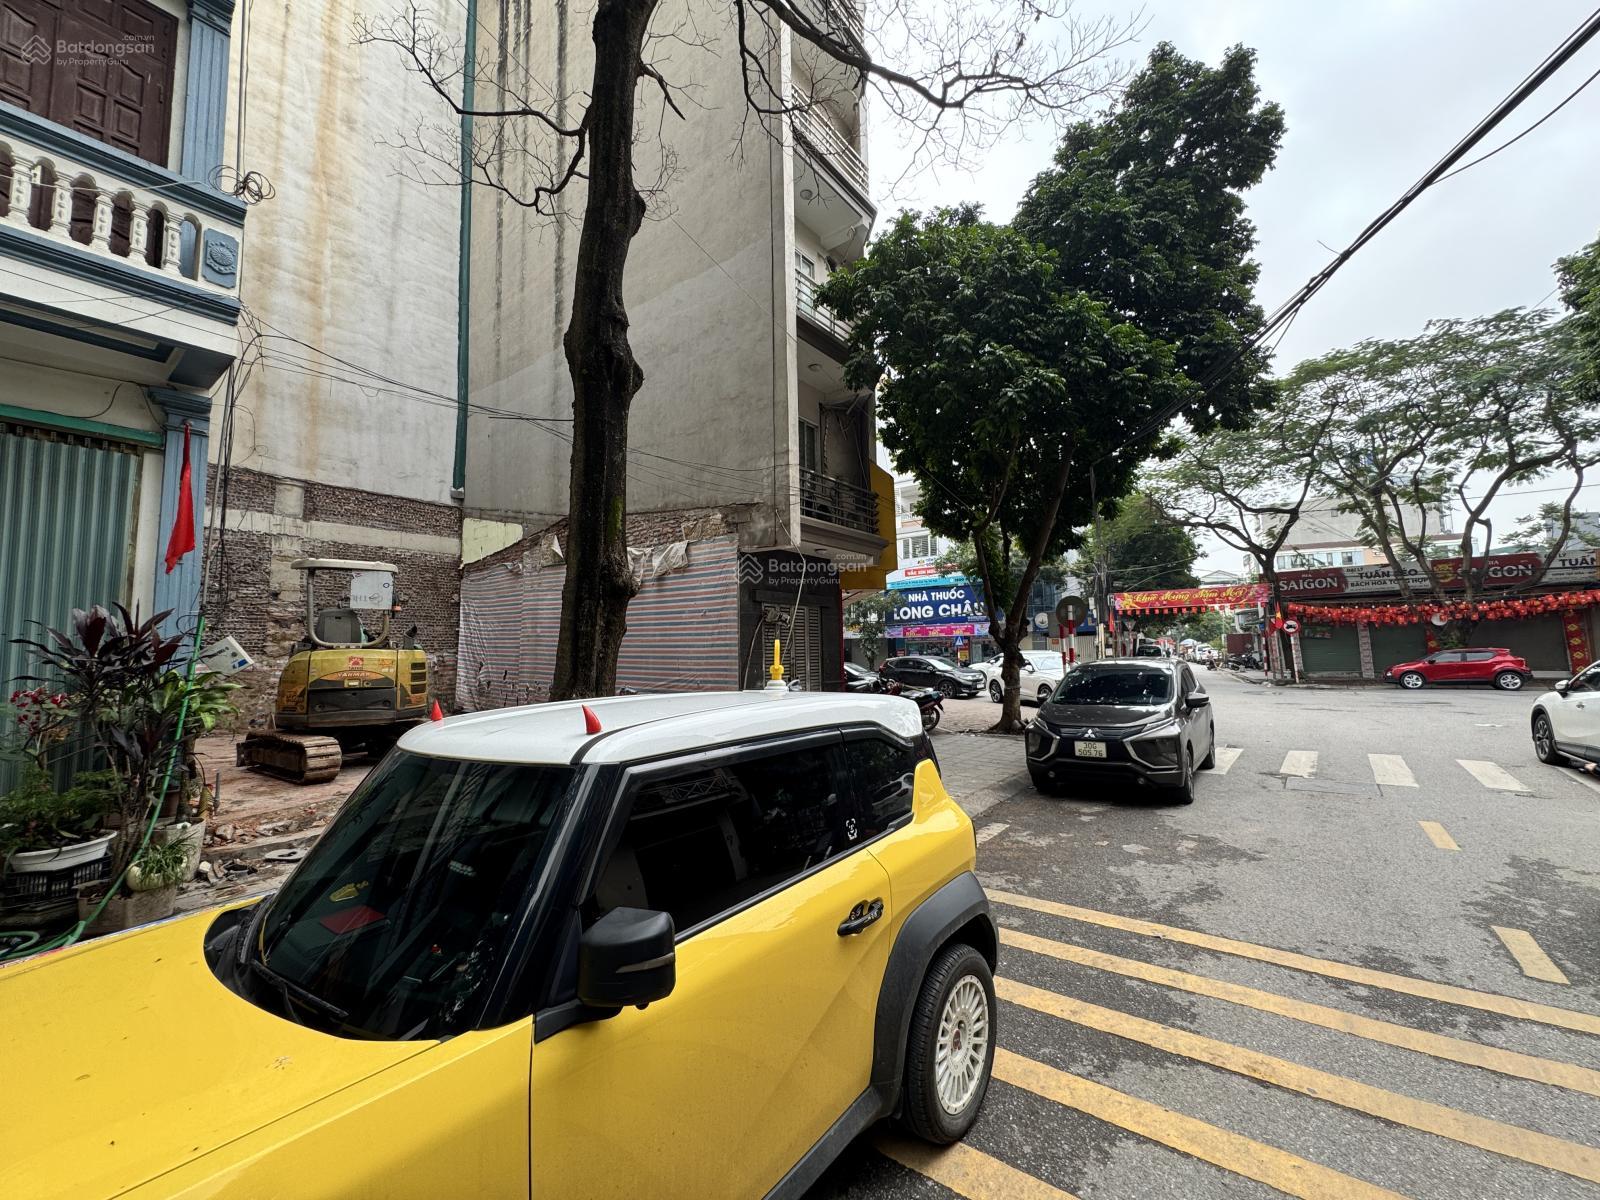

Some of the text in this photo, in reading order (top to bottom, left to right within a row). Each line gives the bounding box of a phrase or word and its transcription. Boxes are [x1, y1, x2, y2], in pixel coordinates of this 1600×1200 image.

[1279, 577, 1339, 591] SAIGON
[908, 587, 965, 602] NHÀ THUỐC
[893, 605, 934, 620] LONG
